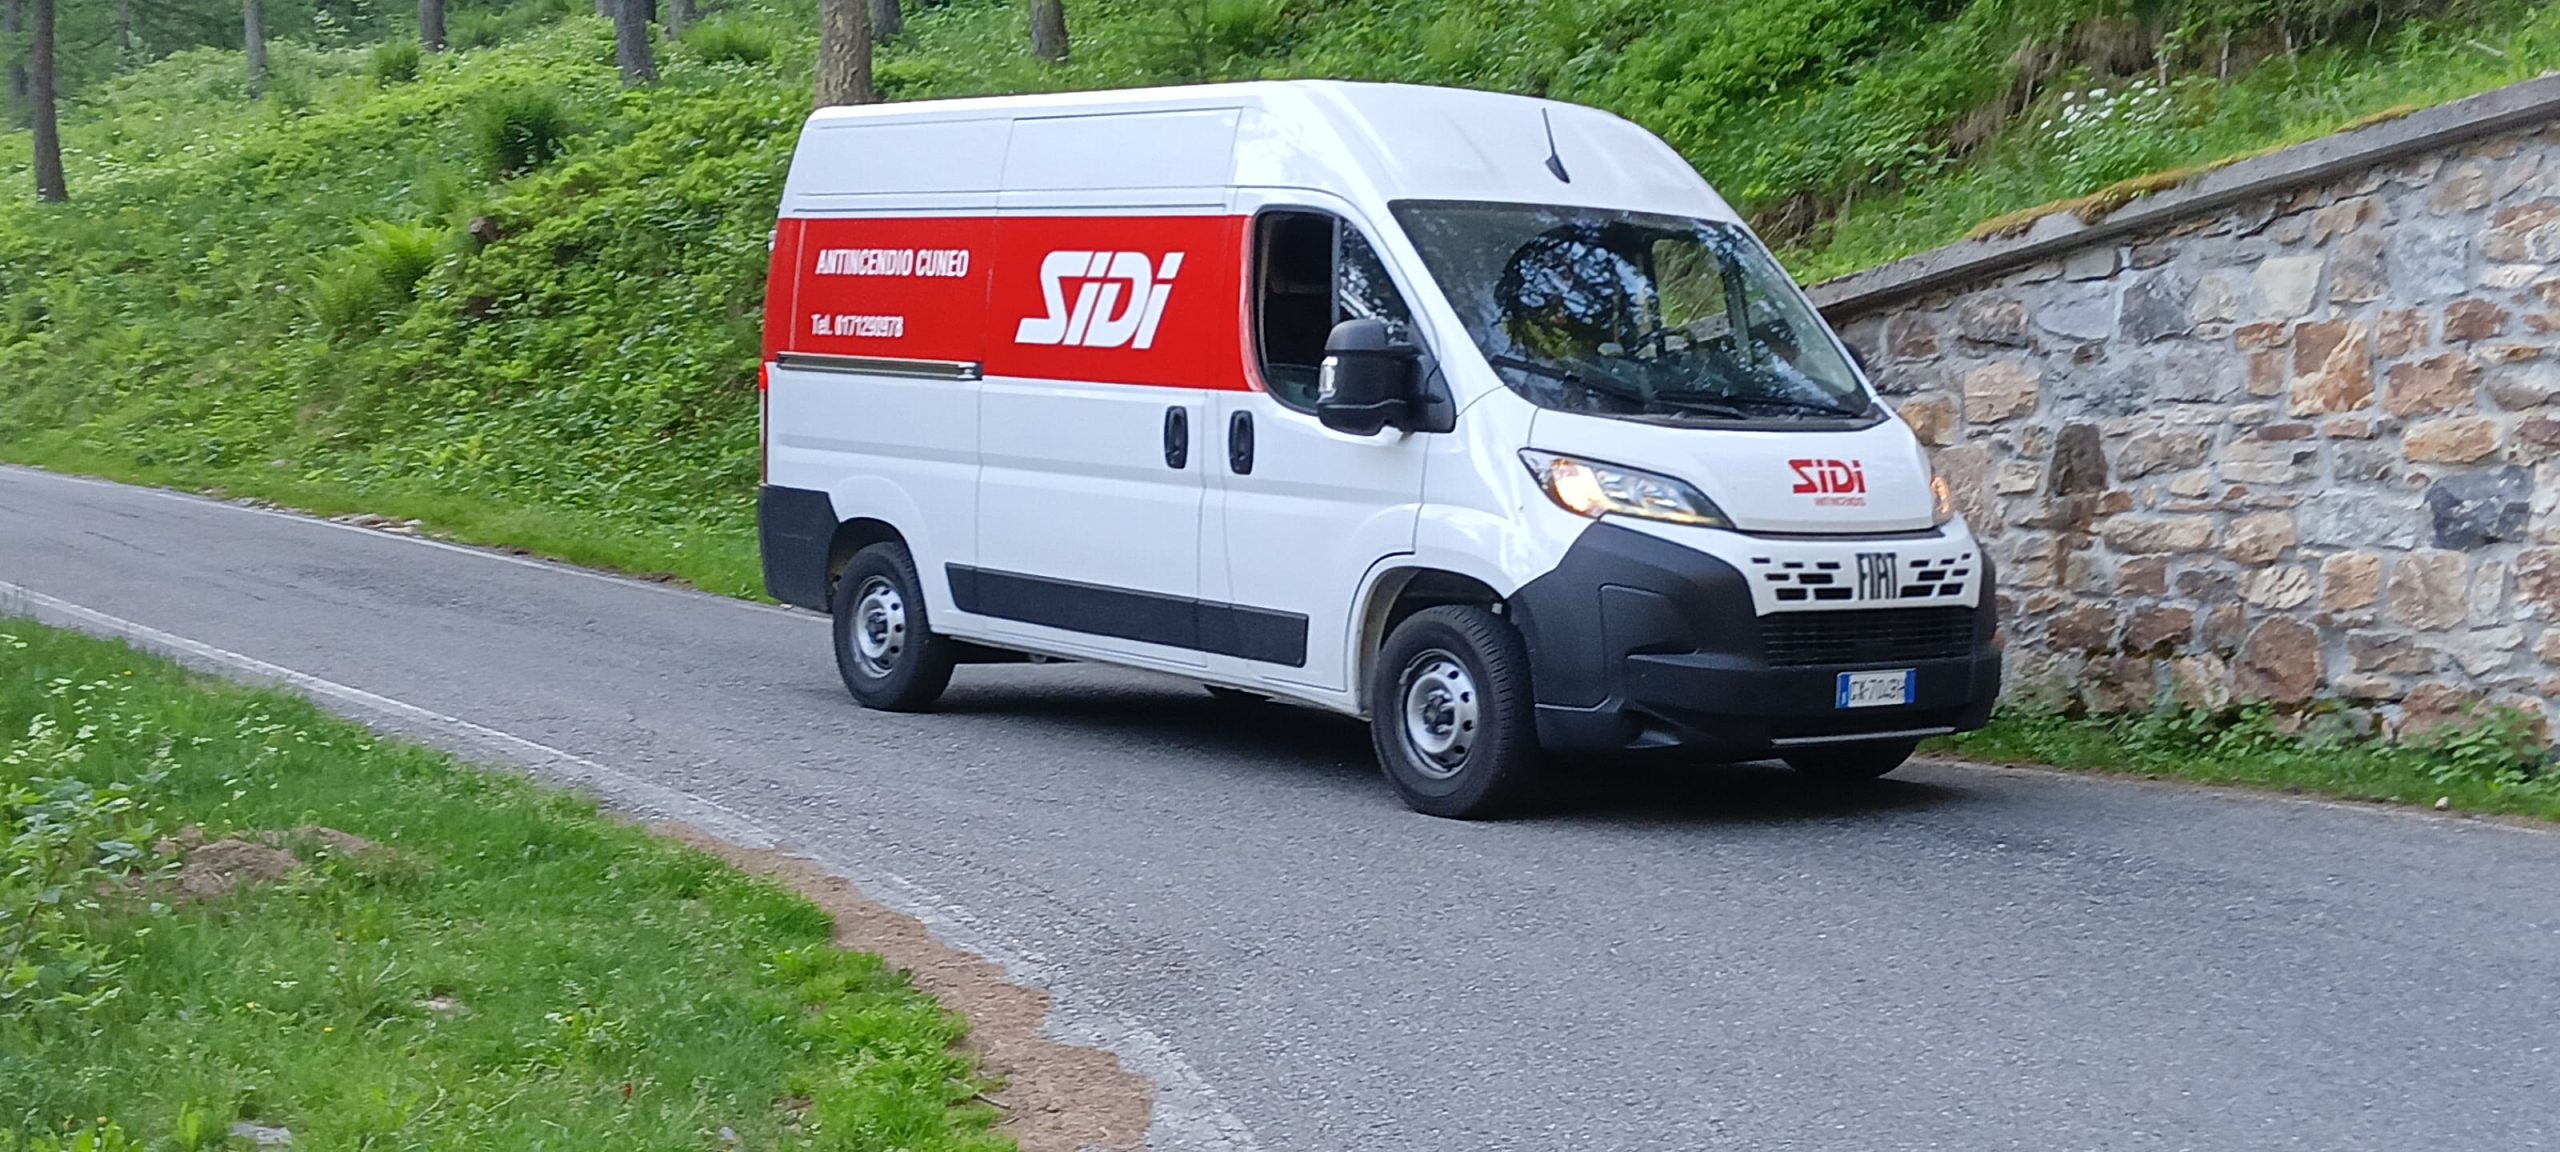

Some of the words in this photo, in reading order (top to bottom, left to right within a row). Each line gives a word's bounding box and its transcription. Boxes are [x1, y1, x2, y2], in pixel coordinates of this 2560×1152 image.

[815, 248, 911, 277] ANTINCENDIO
[914, 248, 969, 278] CUNEO
[811, 313, 832, 335] Tel.
[1856, 552, 1897, 601] FIAT
